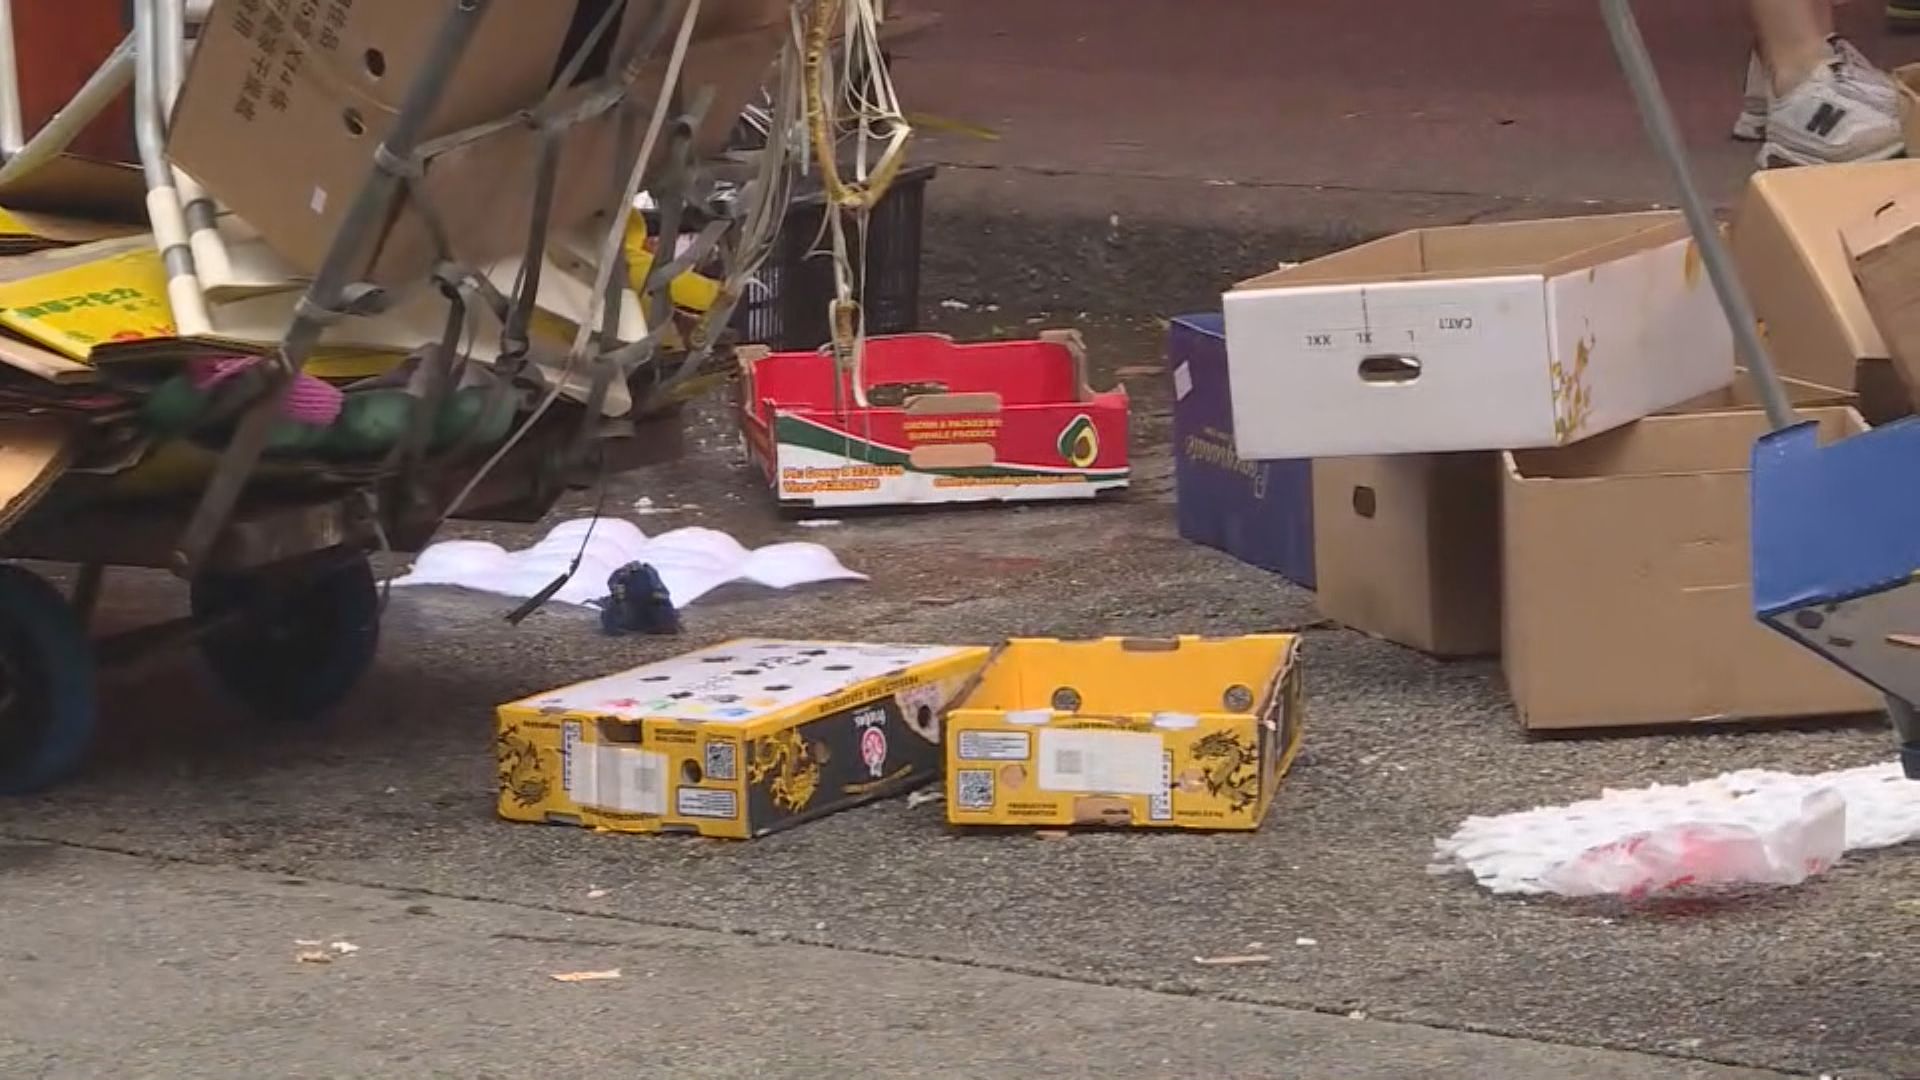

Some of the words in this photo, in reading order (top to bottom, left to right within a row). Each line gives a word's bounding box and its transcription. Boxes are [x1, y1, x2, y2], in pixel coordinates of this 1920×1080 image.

[1806, 102, 1846, 136] N
[1307, 335, 1331, 345] XXL
[1355, 333, 1373, 344] XL
[1407, 330, 1415, 342] L
